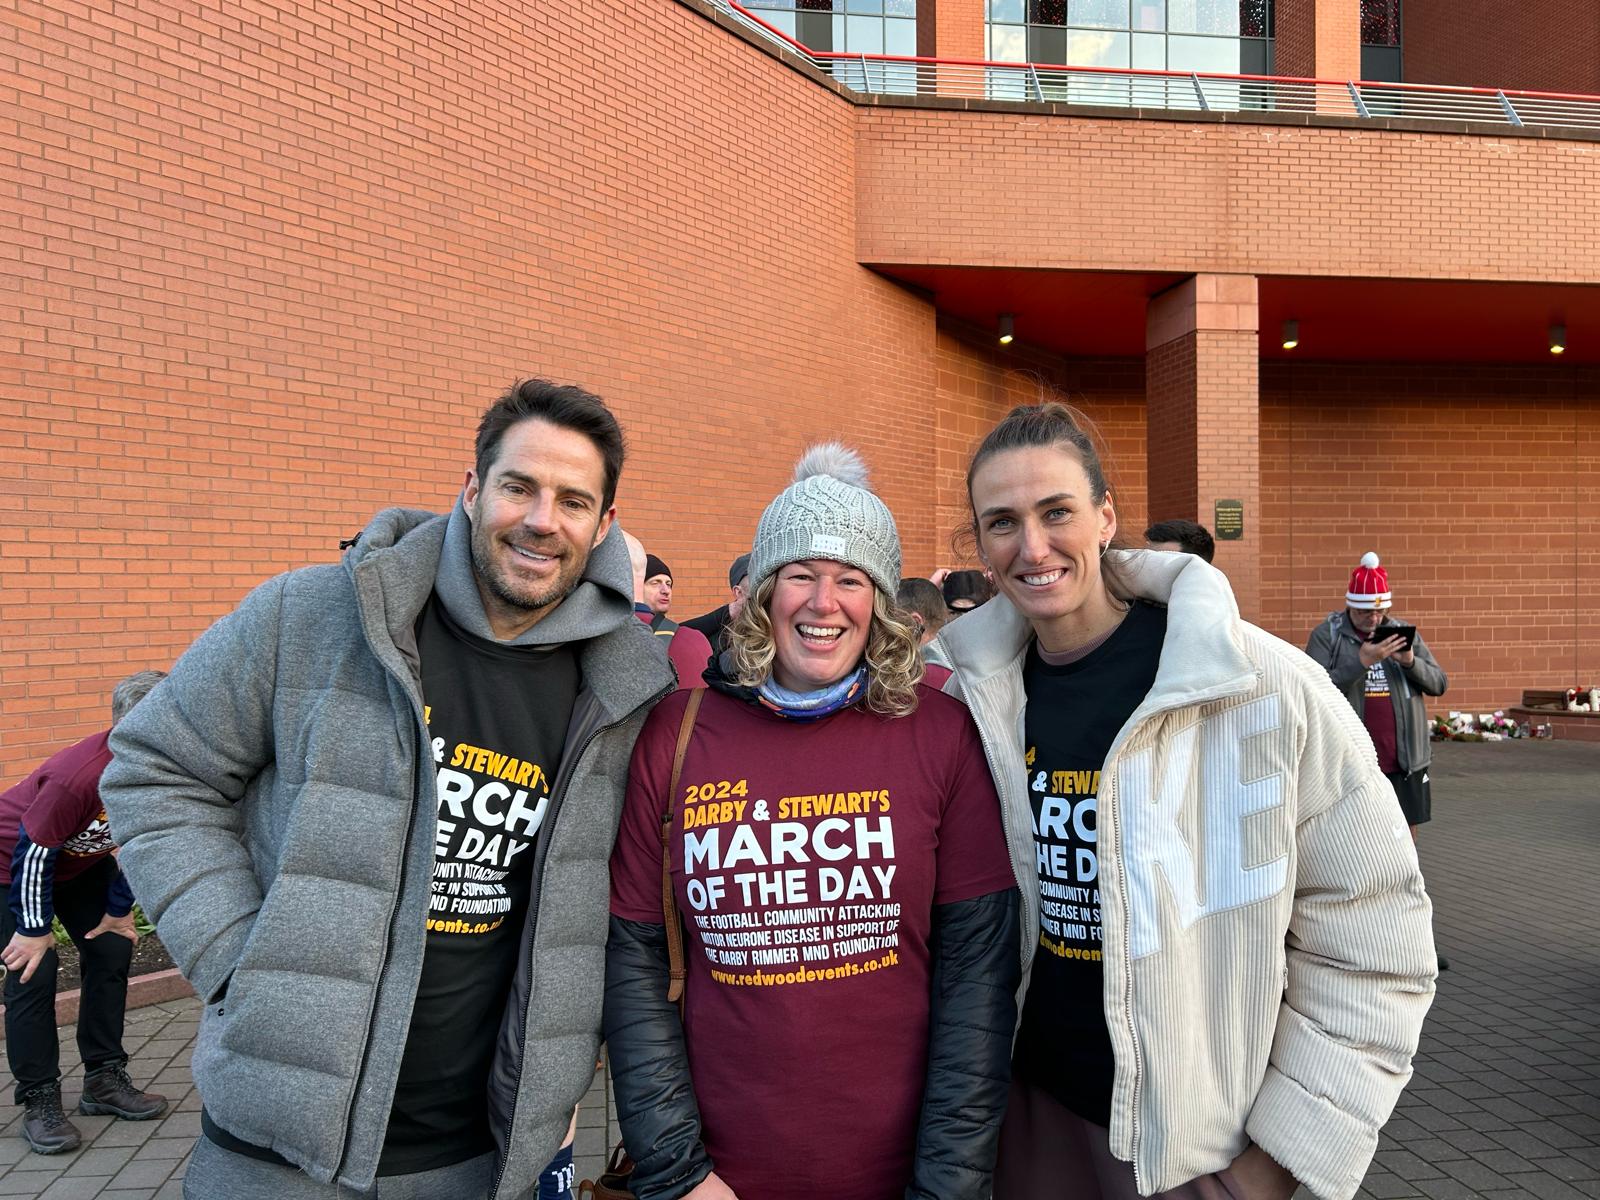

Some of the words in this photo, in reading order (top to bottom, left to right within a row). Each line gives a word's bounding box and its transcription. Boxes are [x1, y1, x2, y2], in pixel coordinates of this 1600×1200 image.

[1367, 670, 1385, 680] THE
[685, 780, 748, 804] 2024
[1032, 771, 1047, 792] &
[684, 801, 747, 829] DARBY
[752, 800, 770, 821] &
[778, 790, 890, 819] STEWART'S
[1031, 797, 1096, 842] RC
[455, 828, 529, 866] DAY
[684, 817, 895, 874] MARCH
[464, 864, 509, 880] ATTACK
[1035, 842, 1068, 879] HE
[447, 882, 460, 895] IN
[687, 876, 725, 911] OF
[734, 869, 808, 907] THE
[818, 865, 896, 901] DAY
[1040, 880, 1089, 903] COMMUNITY
[450, 897, 511, 914] FOUNDATION
[694, 916, 711, 928] THE
[711, 912, 762, 929] FOOTBALL
[764, 907, 834, 926] COMMUNITY
[839, 903, 900, 920] ATTACKING
[1044, 901, 1079, 920] DISEASE
[1080, 908, 1091, 922] IN
[701, 932, 726, 947] MOTOR
[726, 931, 772, 947] NEURONE
[774, 927, 821, 944] DISEASE
[823, 926, 834, 940] IN
[837, 921, 885, 937] SUPPORT
[887, 920, 899, 931] OF
[1063, 923, 1086, 939] MND
[705, 947, 719, 962] THE
[719, 950, 747, 965] DARBY
[752, 947, 798, 965] RIMMER
[803, 945, 829, 961] MND
[833, 933, 898, 958] FOUNDATION
[712, 950, 898, 986] www.redwoodevents.co.uk
